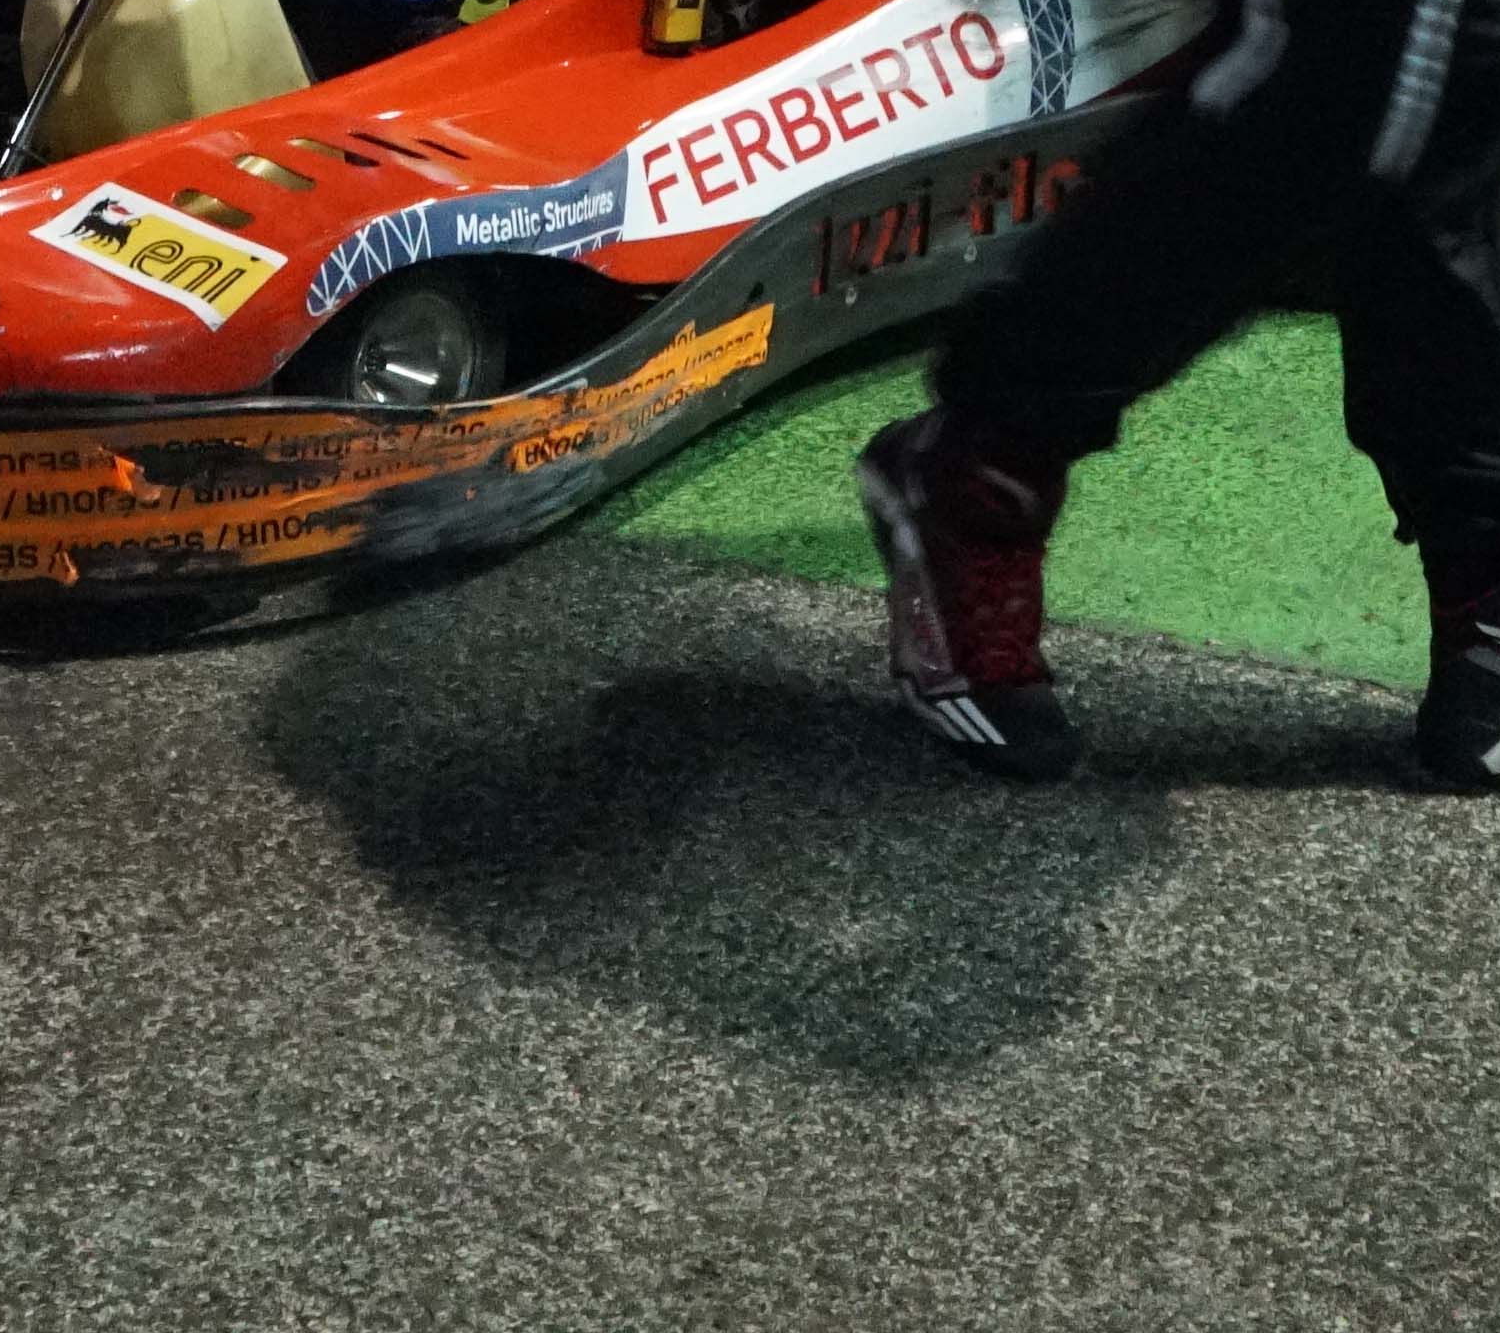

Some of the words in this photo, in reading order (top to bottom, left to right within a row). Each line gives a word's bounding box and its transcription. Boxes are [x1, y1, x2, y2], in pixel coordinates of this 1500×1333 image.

[641, 9, 1007, 225] FERBERTO
[455, 200, 541, 247] Metallic
[543, 187, 615, 232] Structures
[128, 238, 262, 303] eni
